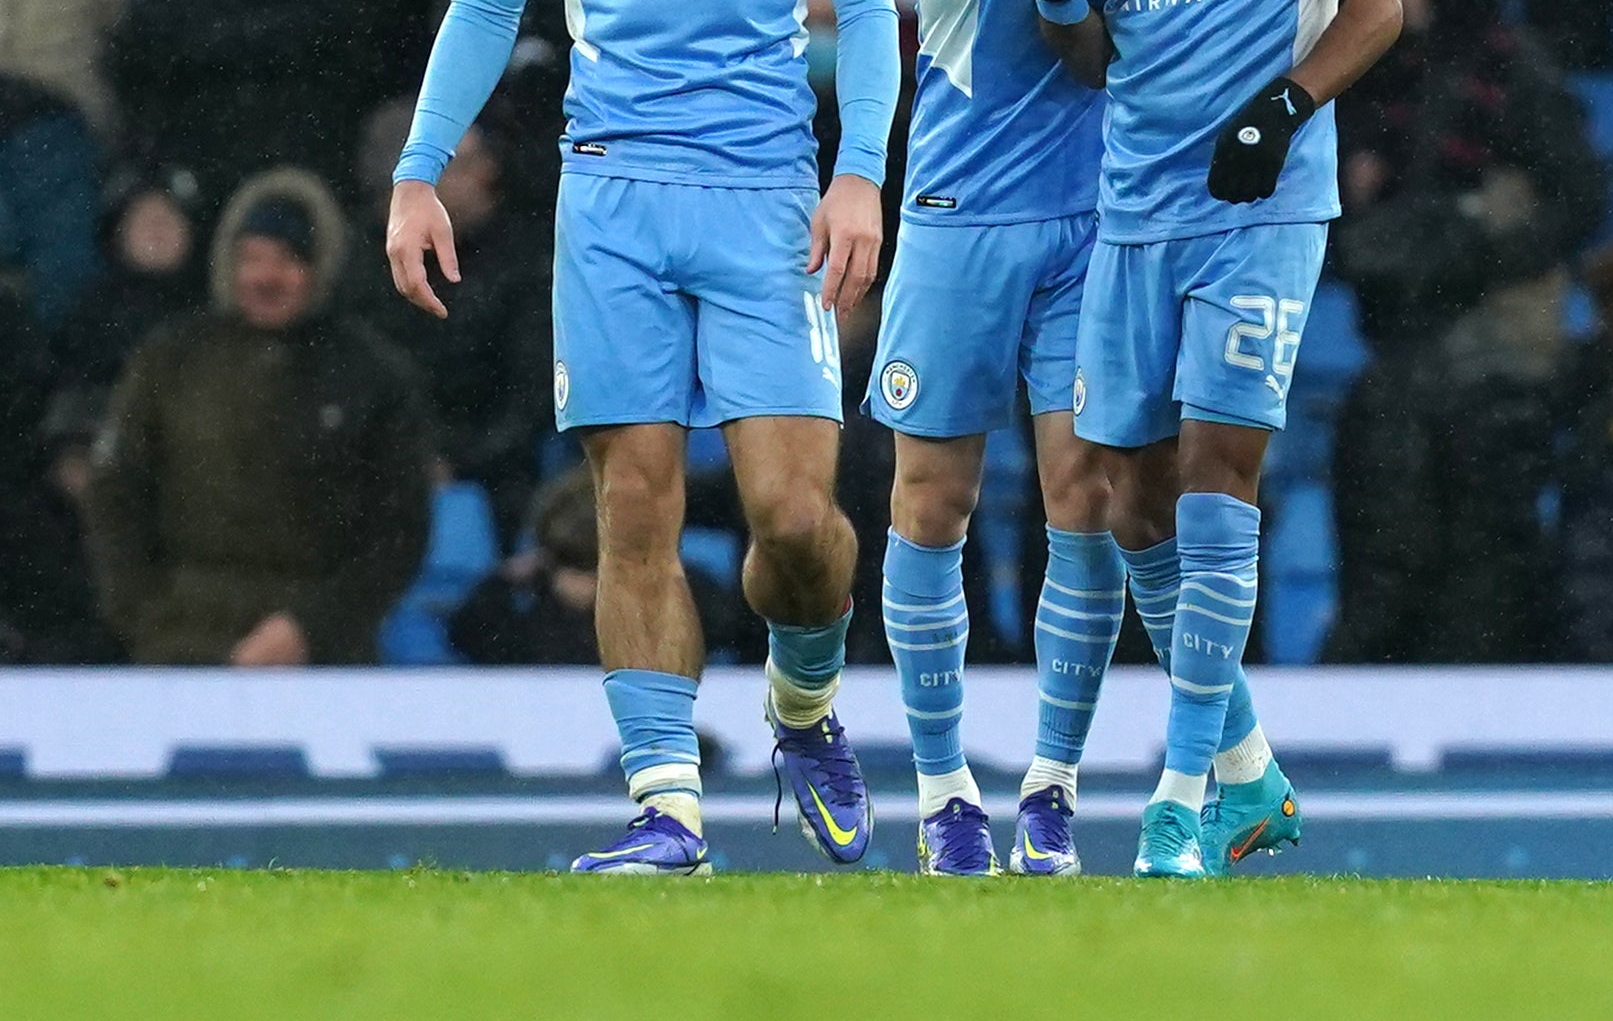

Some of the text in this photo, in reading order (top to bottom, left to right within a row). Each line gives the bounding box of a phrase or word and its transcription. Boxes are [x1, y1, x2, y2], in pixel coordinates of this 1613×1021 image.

[1183, 632, 1234, 659] CITY
[919, 665, 963, 688] CITY
[1052, 658, 1102, 678] CITY
